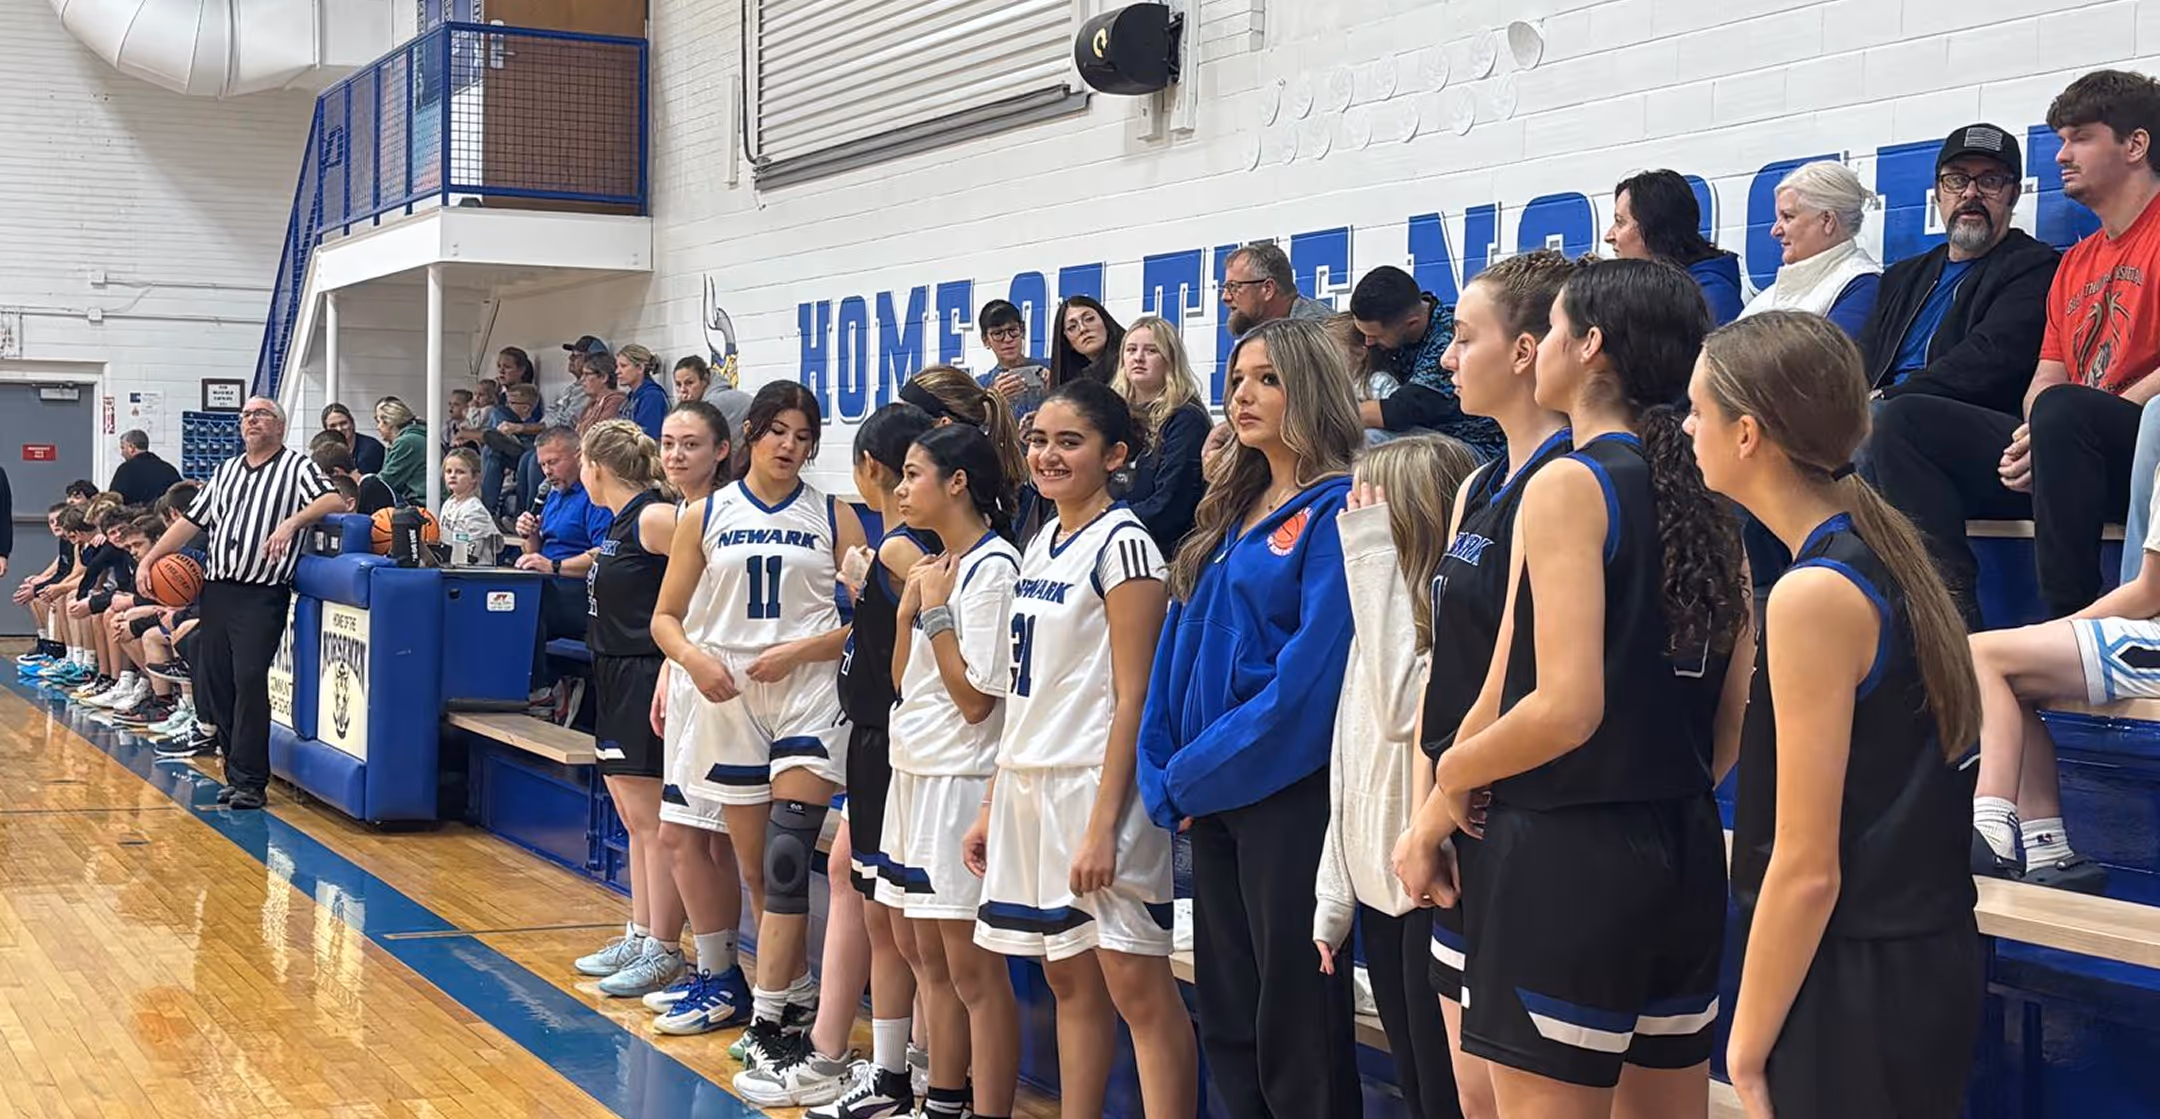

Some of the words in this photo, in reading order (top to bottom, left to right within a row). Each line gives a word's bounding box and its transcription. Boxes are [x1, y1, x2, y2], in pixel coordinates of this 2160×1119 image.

[797, 277, 976, 424] HOME
[718, 529, 819, 550] NEWARK
[746, 555, 782, 619] 11
